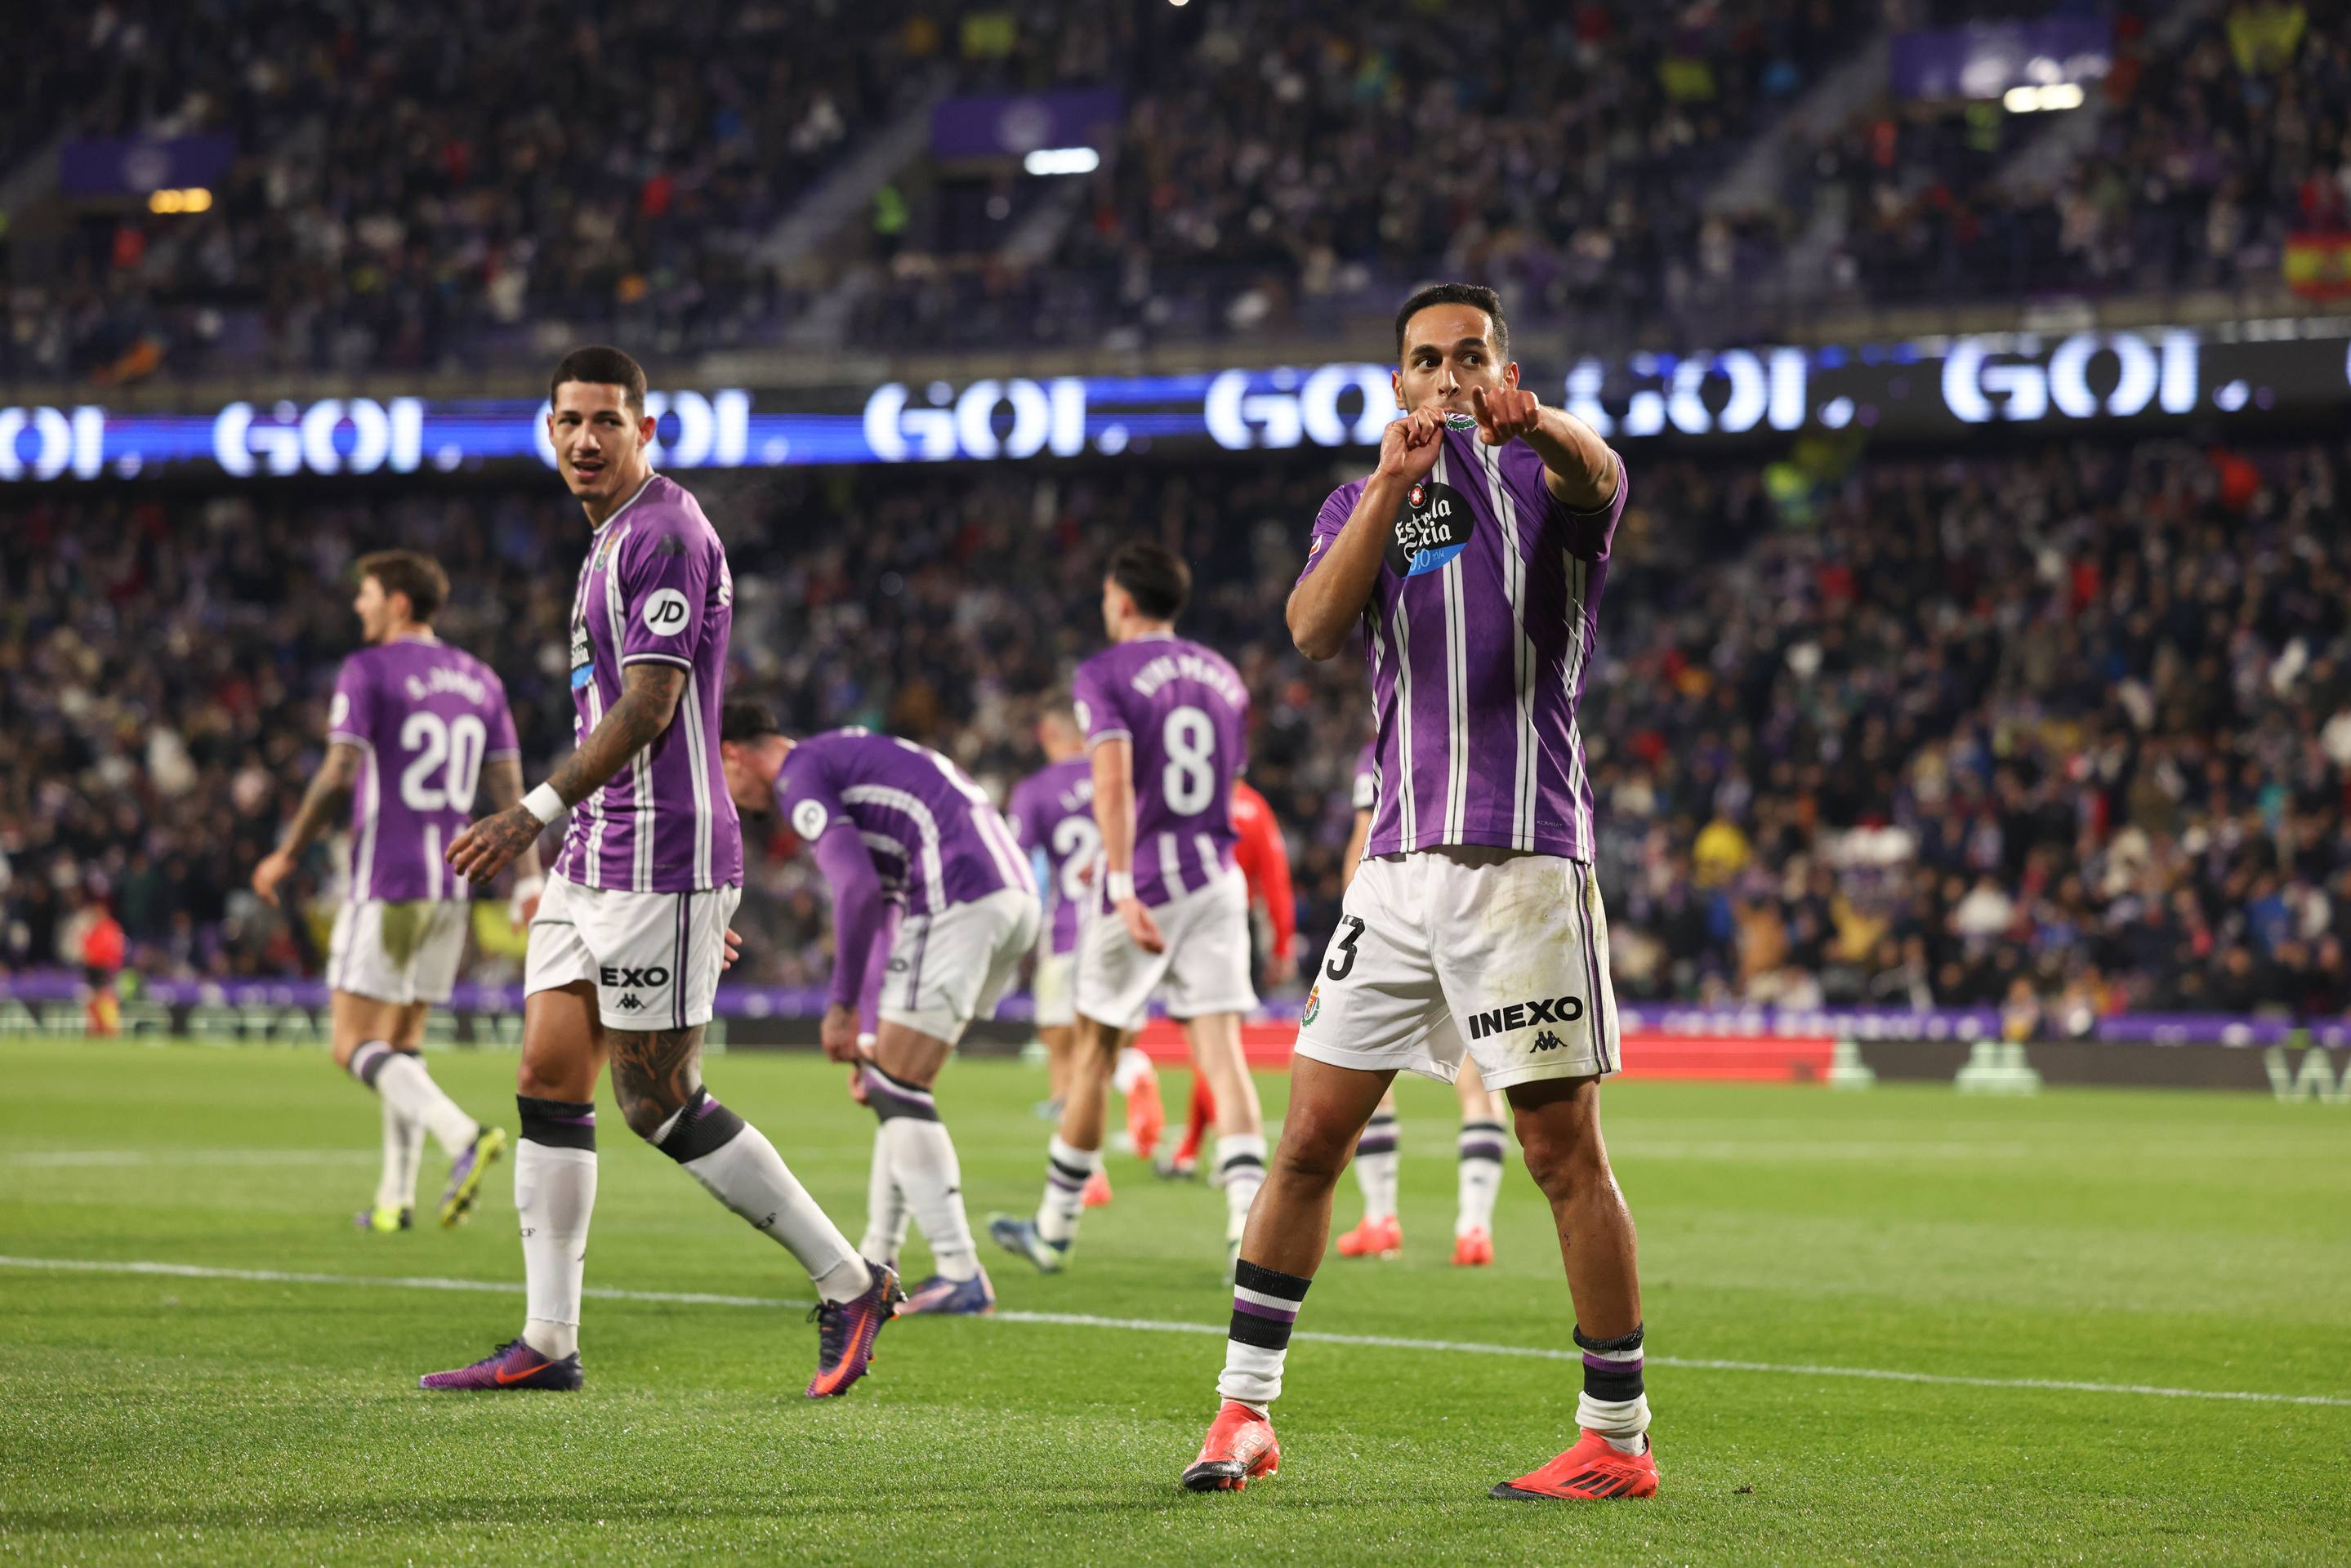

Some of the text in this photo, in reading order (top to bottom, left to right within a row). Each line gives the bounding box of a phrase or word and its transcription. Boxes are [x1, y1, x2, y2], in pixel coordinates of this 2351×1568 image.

[1204, 363, 1402, 451] GO
[650, 600, 685, 623] JD
[399, 710, 488, 814] 20
[1162, 705, 1216, 816] 8
[600, 967, 670, 988] EXO
[1322, 915, 1366, 981] 3
[1468, 996, 1583, 1040] INEXO
